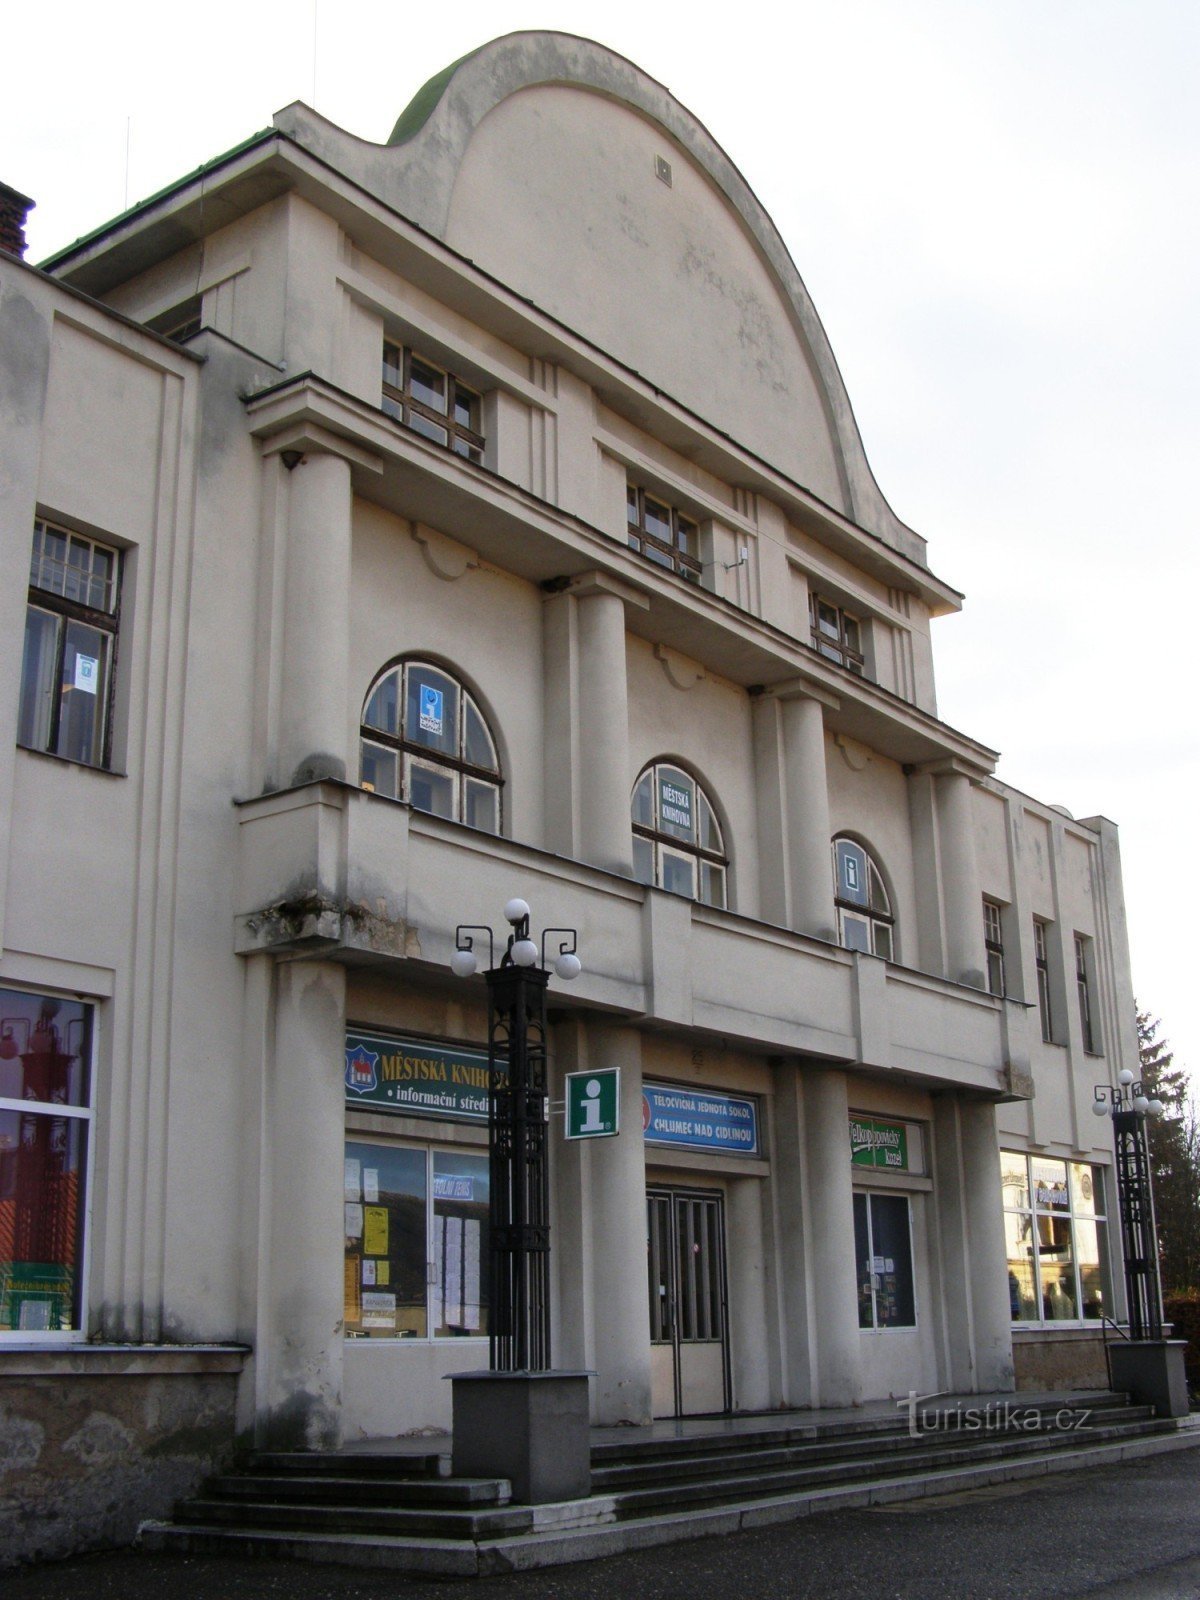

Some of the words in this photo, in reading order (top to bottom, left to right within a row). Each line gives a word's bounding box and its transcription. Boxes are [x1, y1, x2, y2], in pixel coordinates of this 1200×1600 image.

[662, 784, 689, 808] MĚSTSKÁ
[662, 803, 690, 828] KNIHOVNA
[381, 1051, 447, 1082] MĚSTSKÁ
[396, 1085, 456, 1107] informační
[697, 1101, 728, 1116] JEDNOTA
[729, 1106, 750, 1119] SOKOL
[654, 1119, 693, 1134] CHLUMEC
[694, 1124, 713, 1137] NAD
[715, 1126, 752, 1142] CIDLINOU
